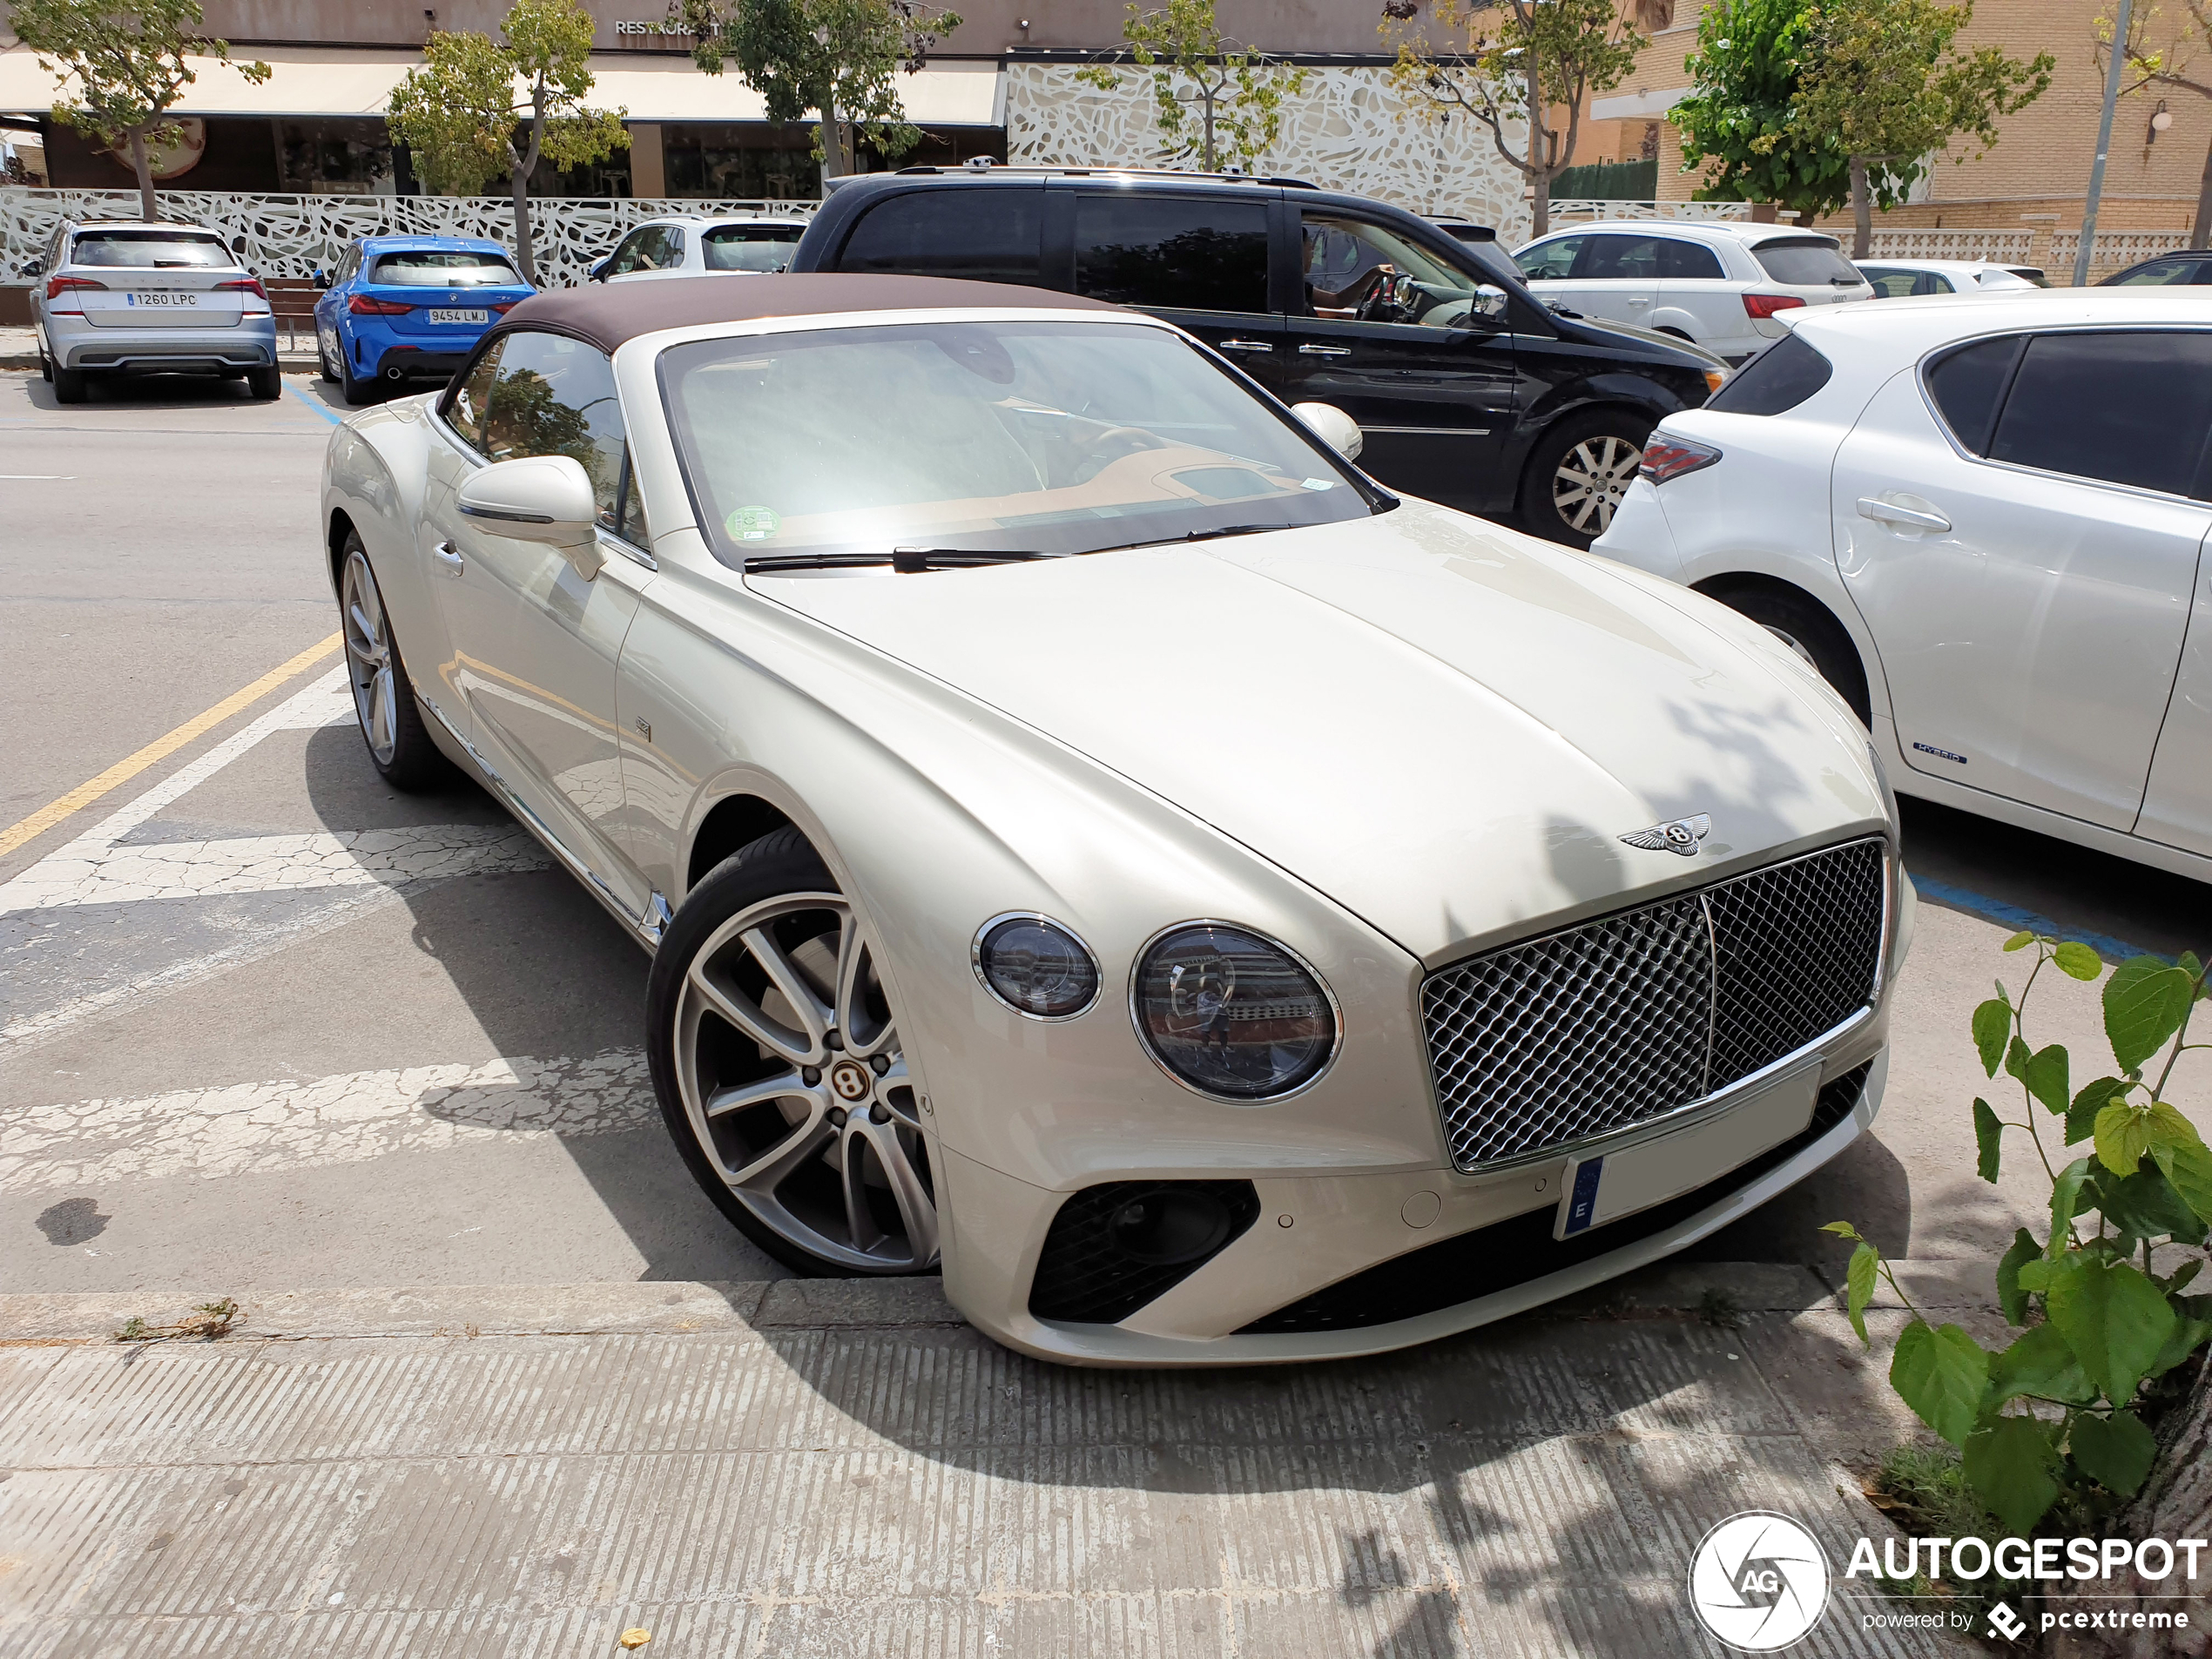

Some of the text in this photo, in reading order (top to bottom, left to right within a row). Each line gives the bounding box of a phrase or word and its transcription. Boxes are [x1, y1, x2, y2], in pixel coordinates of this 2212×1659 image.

[136, 294, 196, 306] 1260 LPC
[432, 310, 486, 322] 9454 LMJ
[1919, 744, 1960, 763] HYBRID
[1575, 1202, 1588, 1218] E
